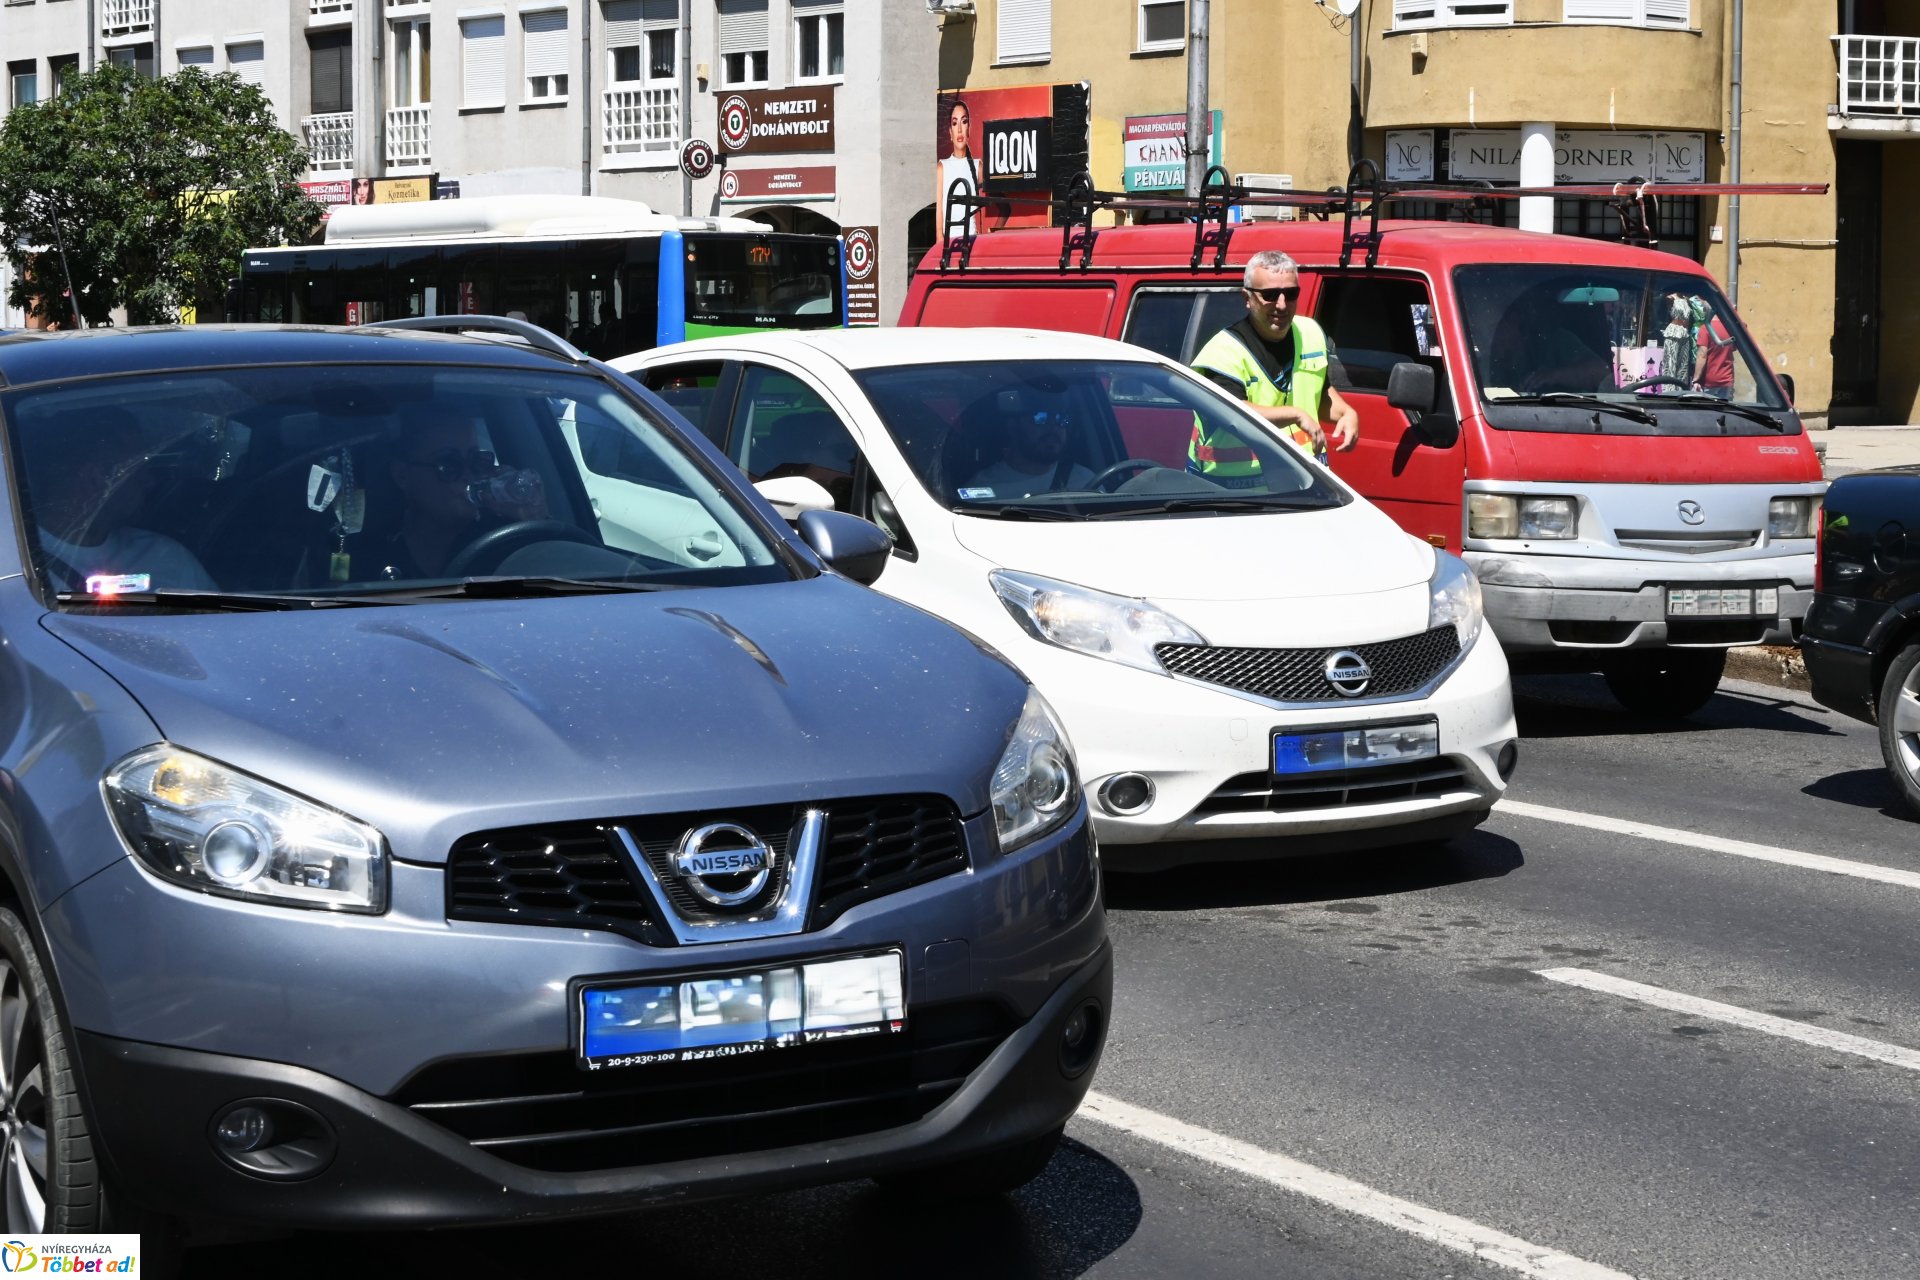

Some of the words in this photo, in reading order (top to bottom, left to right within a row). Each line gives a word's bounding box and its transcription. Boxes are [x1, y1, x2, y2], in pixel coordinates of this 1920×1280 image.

[764, 99, 817, 116] NEMZETI
[732, 117, 739, 129] T
[752, 119, 830, 137] DOHÁNYBOLT
[1129, 124, 1152, 134] MAGYAR
[1152, 121, 1181, 131] PÉNZVÁLTÓ
[989, 130, 1037, 174] IQON
[1396, 143, 1422, 167] NC
[1470, 148, 1522, 165] NILA
[1554, 149, 1634, 166] ORNER
[1664, 143, 1692, 169] NC
[696, 155, 703, 163] T
[310, 184, 346, 193] HASZNÁLT
[726, 181, 734, 190] 18
[388, 189, 420, 201] Kozmetika
[856, 249, 862, 260] T
[1758, 446, 1799, 454] E2200
[1333, 669, 1370, 679] NISSAN
[692, 852, 766, 871] NISSAN
[608, 1053, 676, 1067] 20-9-230-100
